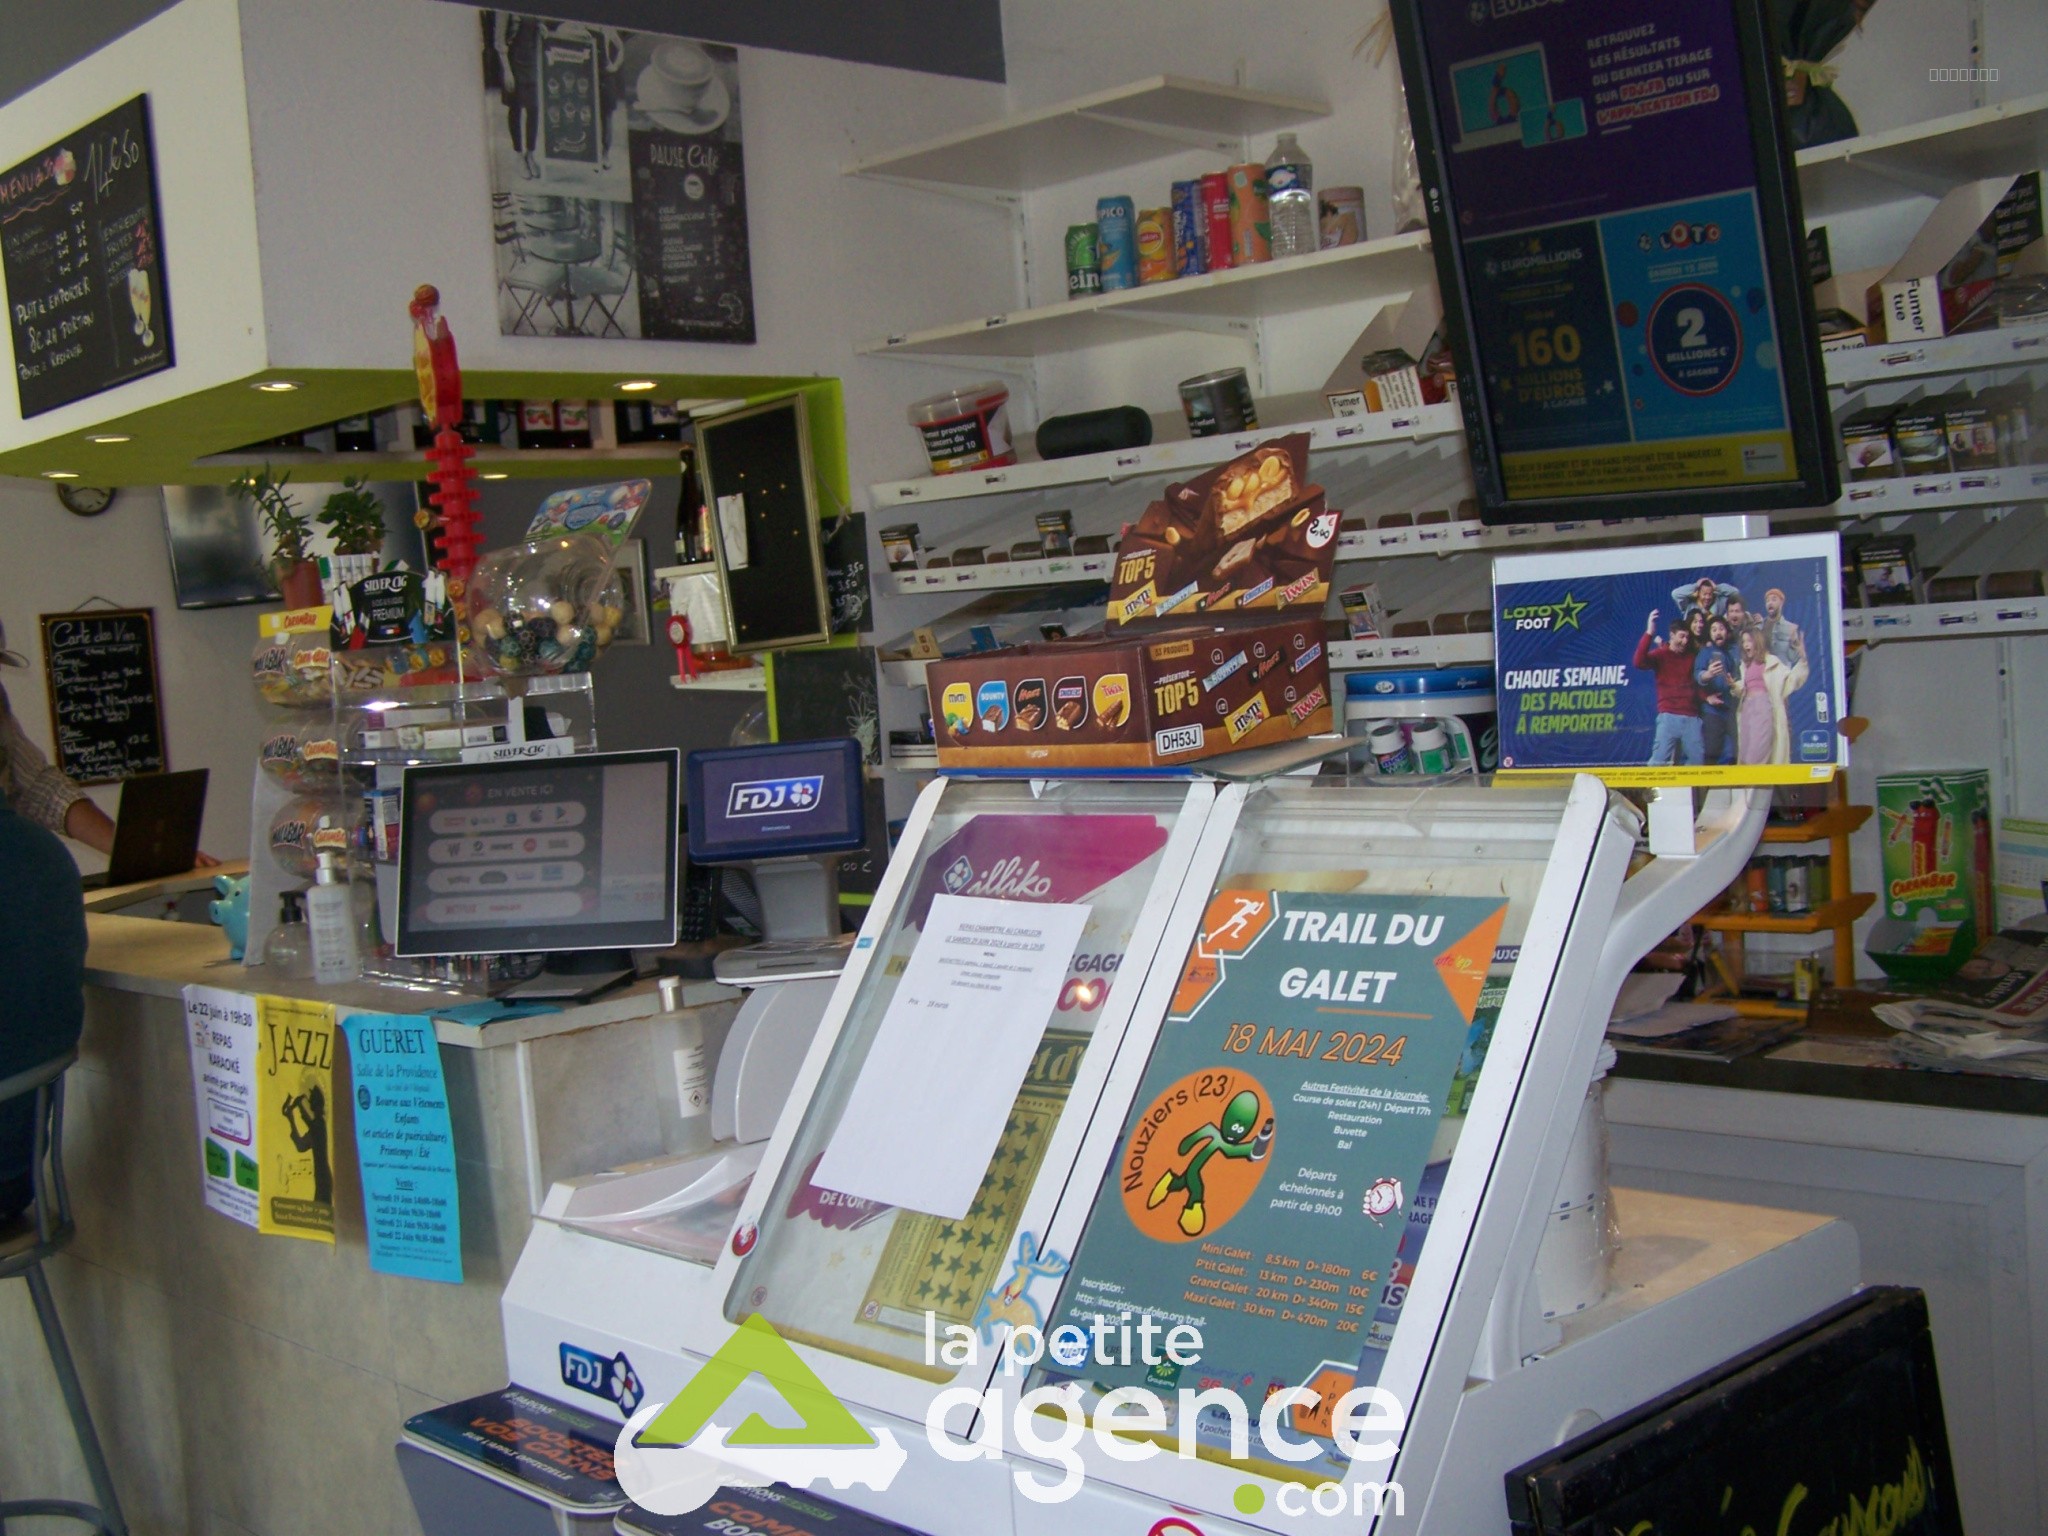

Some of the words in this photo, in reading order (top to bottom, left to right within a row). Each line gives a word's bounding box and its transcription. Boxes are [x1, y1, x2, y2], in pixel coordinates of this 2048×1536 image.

[1587, 23, 1656, 50] RETROUVEZ
[1589, 54, 1612, 69] LES
[1613, 36, 1681, 63] RÉSULTATS
[1592, 72, 1609, 86] DU
[1610, 60, 1664, 83] DERNIER
[1665, 48, 1713, 69] TIRAGE
[1595, 90, 1618, 104] SUR
[1666, 75, 1684, 88] OU
[1686, 68, 1711, 84] SUR
[1692, 86, 1719, 102] FDJ
[1658, 221, 1721, 250] LOTO
[1501, 248, 1583, 272] EUROMILLIONS
[1893, 292, 1905, 321] tue
[1907, 277, 1926, 333] Fumer
[1676, 307, 1708, 348] 2
[1509, 324, 1581, 367] 160
[1666, 348, 1716, 363] MILLIONS
[1516, 368, 1582, 386] MILLIONS
[1332, 397, 1361, 408] Fumer
[1518, 382, 1586, 402] D'EUROS
[941, 422, 976, 437] provoque
[1118, 559, 1144, 585] TOP
[1145, 555, 1156, 580] 5
[1503, 605, 1551, 619] LOTO
[1516, 617, 1551, 630] FOOT
[53, 621, 92, 647] Carte
[1505, 667, 1561, 690] CHAQUE
[1563, 665, 1629, 687] SEMAINE,
[1155, 683, 1182, 716] TOP
[1186, 677, 1199, 707] 5
[1521, 692, 1547, 712] DES
[1550, 689, 1616, 710] PACTOLES
[1516, 712, 1527, 735] À
[493, 746, 524, 759] SILVER
[526, 744, 546, 758] CIG
[1162, 729, 1198, 751] DH53J
[505, 786, 537, 797] VENTE
[734, 785, 786, 810] FDJ
[968, 855, 1052, 897] illiko
[1283, 910, 1378, 944] TRAIL
[1384, 913, 1444, 947] DU
[1279, 967, 1397, 1003] GALET
[188, 1000, 198, 1014] Le
[199, 1002, 209, 1016] 22
[212, 1031, 233, 1049] REPAS
[360, 1021, 425, 1053] GUÉRET
[1222, 1023, 1257, 1053] 18
[1257, 1026, 1319, 1060] MAI
[1321, 1030, 1408, 1066] 2024
[268, 1024, 332, 1076] JAZZ
[1301, 1081, 1329, 1093] Autres
[1330, 1083, 1369, 1097] Festivités
[1371, 1088, 1382, 1097] de
[1382, 1087, 1391, 1098] la
[1293, 1093, 1321, 1104] Course
[1323, 1096, 1334, 1106] de
[1334, 1097, 1356, 1109] solex
[1358, 1100, 1381, 1112] (24h)
[1384, 1103, 1415, 1115] Départ
[1416, 1106, 1431, 1116] 17h
[1328, 1111, 1382, 1125] Restauration
[1124, 1089, 1188, 1193] Nouziers
[1193, 1074, 1235, 1103] (23)
[1333, 1126, 1367, 1137] Buvette
[1337, 1140, 1352, 1149] Bal
[1298, 1167, 1337, 1181] Départs
[819, 1191, 835, 1204] DE
[1279, 1181, 1336, 1199] échelonnés
[1337, 1191, 1344, 1200] à
[1270, 1198, 1297, 1211] partir
[1299, 1202, 1312, 1212] de
[1314, 1204, 1342, 1216] 9h00
[1201, 1243, 1223, 1255] Mini
[1224, 1246, 1251, 1260] Galet
[1282, 1256, 1300, 1269] km
[1322, 1263, 1351, 1277] 180m
[1362, 1270, 1378, 1281] 6€
[1080, 1277, 1121, 1293] Inscription
[1196, 1258, 1215, 1272] P'tit
[1218, 1261, 1245, 1276] Galet
[1259, 1269, 1270, 1279] 13
[1271, 1272, 1288, 1284] km
[1309, 1278, 1340, 1293] 230m
[1349, 1285, 1370, 1298] 10€
[1190, 1274, 1220, 1289] Grand
[1221, 1280, 1248, 1294] Galet
[1256, 1287, 1270, 1298] 20
[1271, 1289, 1289, 1302] km
[1307, 1296, 1339, 1311] 340m
[1345, 1303, 1365, 1316] 15€
[1184, 1291, 1208, 1305] Maxi
[1209, 1295, 1236, 1309] Galet
[1243, 1302, 1258, 1313] 30
[1258, 1305, 1276, 1317] km
[1297, 1311, 1328, 1328] 470m
[1336, 1319, 1360, 1333] 20€
[564, 1353, 602, 1391] FDJ
[470, 1416, 527, 1443] VOS
[524, 1441, 616, 1481] GAINS
